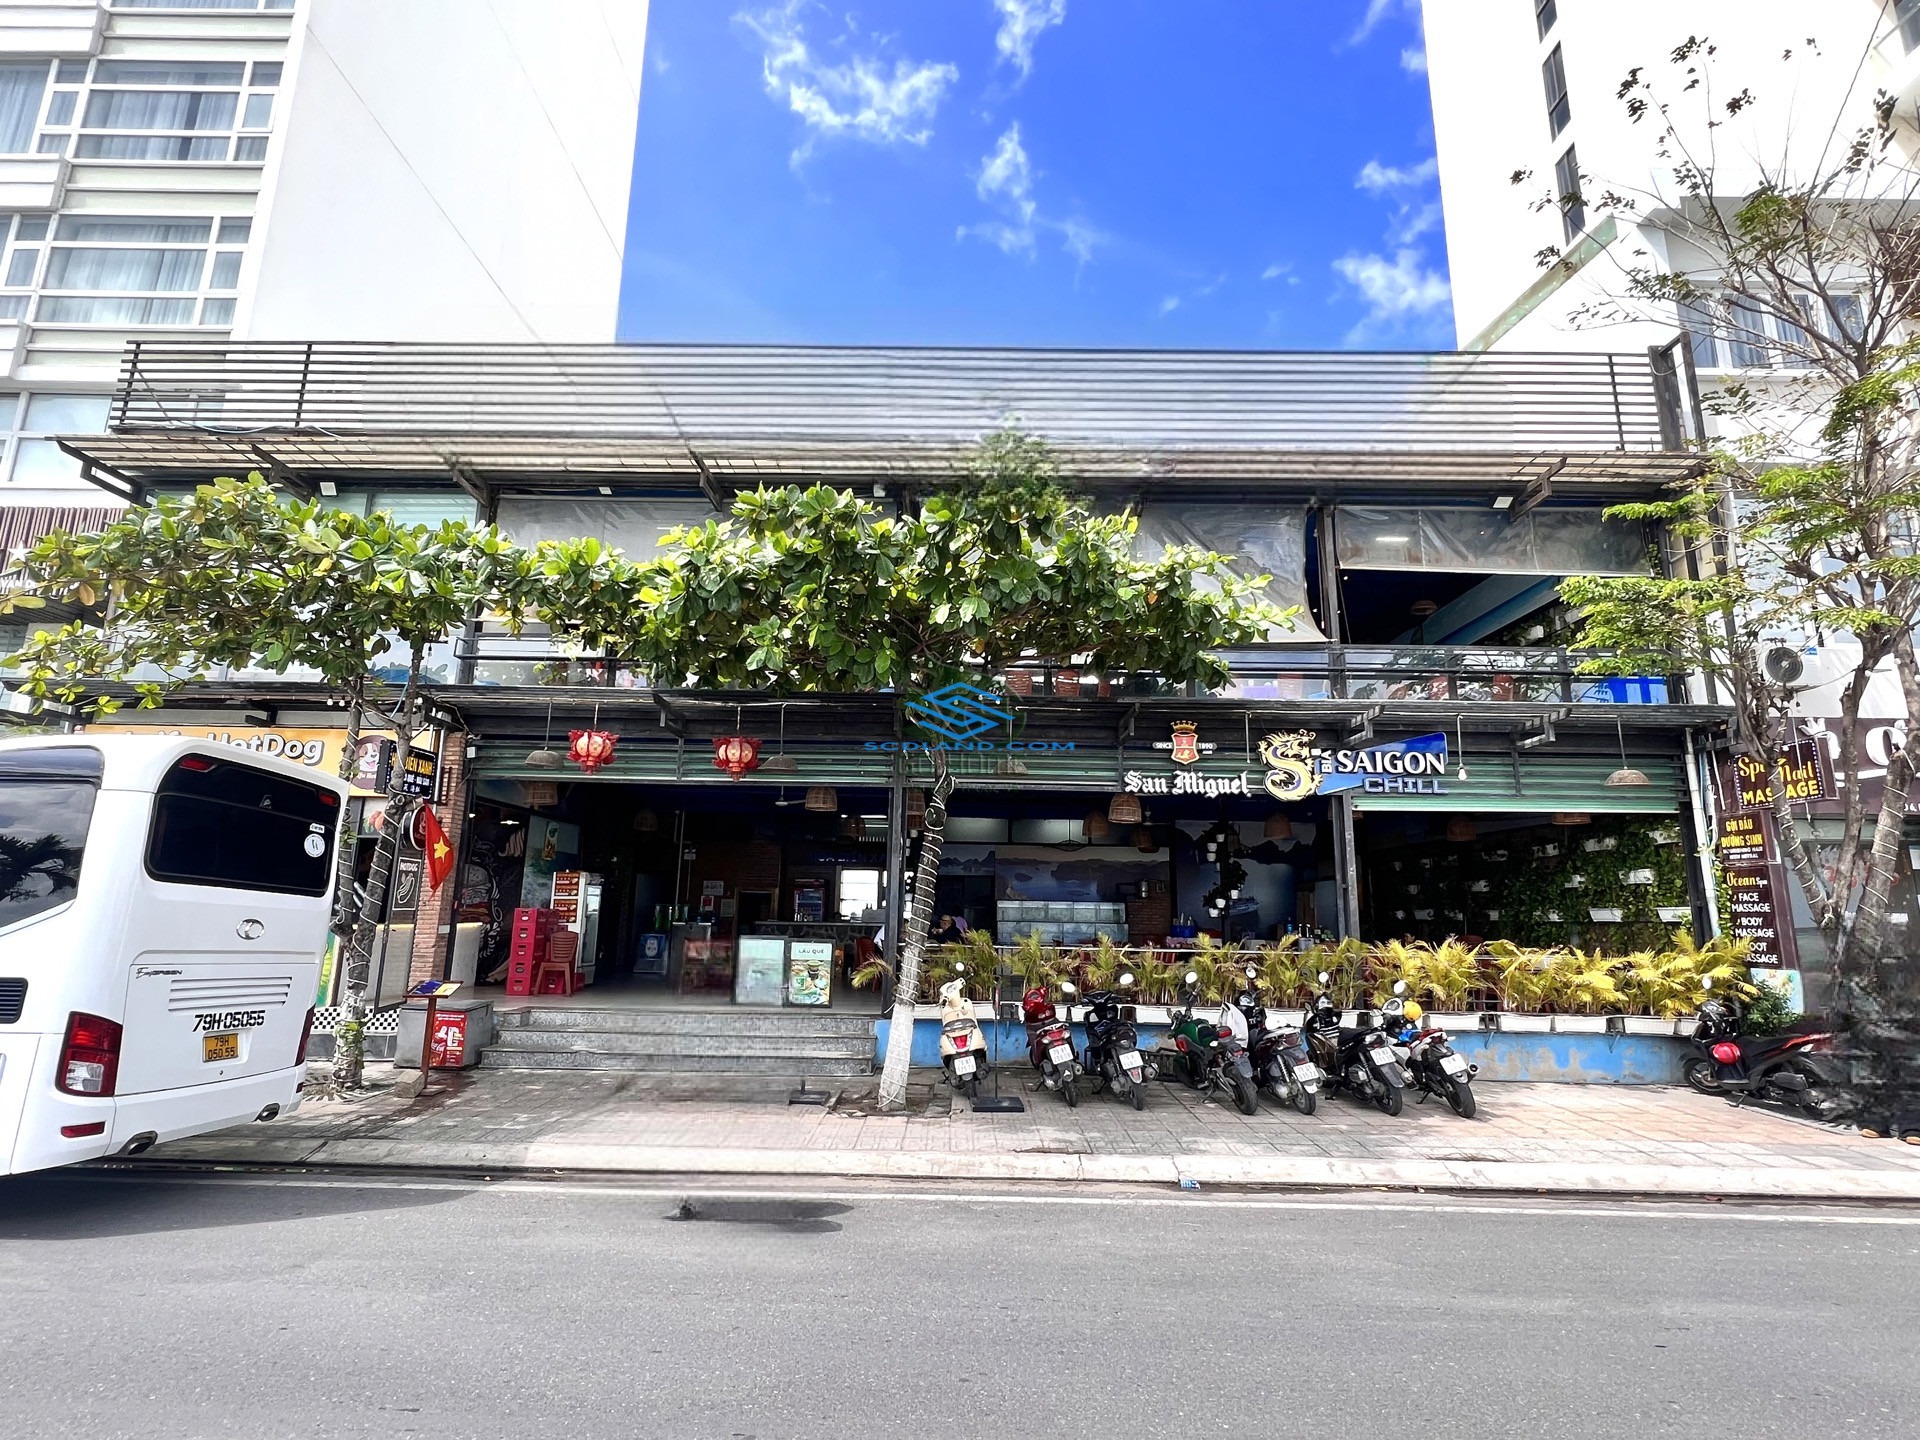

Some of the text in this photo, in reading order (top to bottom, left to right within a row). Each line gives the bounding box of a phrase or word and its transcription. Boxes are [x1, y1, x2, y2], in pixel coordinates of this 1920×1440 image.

[1321, 750, 1332, 773] BIA
[1337, 751, 1446, 775] SAIGON
[1124, 770, 1169, 793] San
[1363, 777, 1449, 794] CHILL
[1742, 779, 1820, 806] MASAGE
[1726, 870, 1757, 887] Ocean
[1738, 892, 1760, 902] FACE
[1731, 903, 1771, 912] MASSAGE
[1740, 917, 1763, 926] BODY
[1735, 928, 1775, 938] MASSAGE
[1749, 942, 1768, 952] OOT
[1745, 953, 1779, 964] ASSAGE
[214, 1037, 230, 1047] 79H
